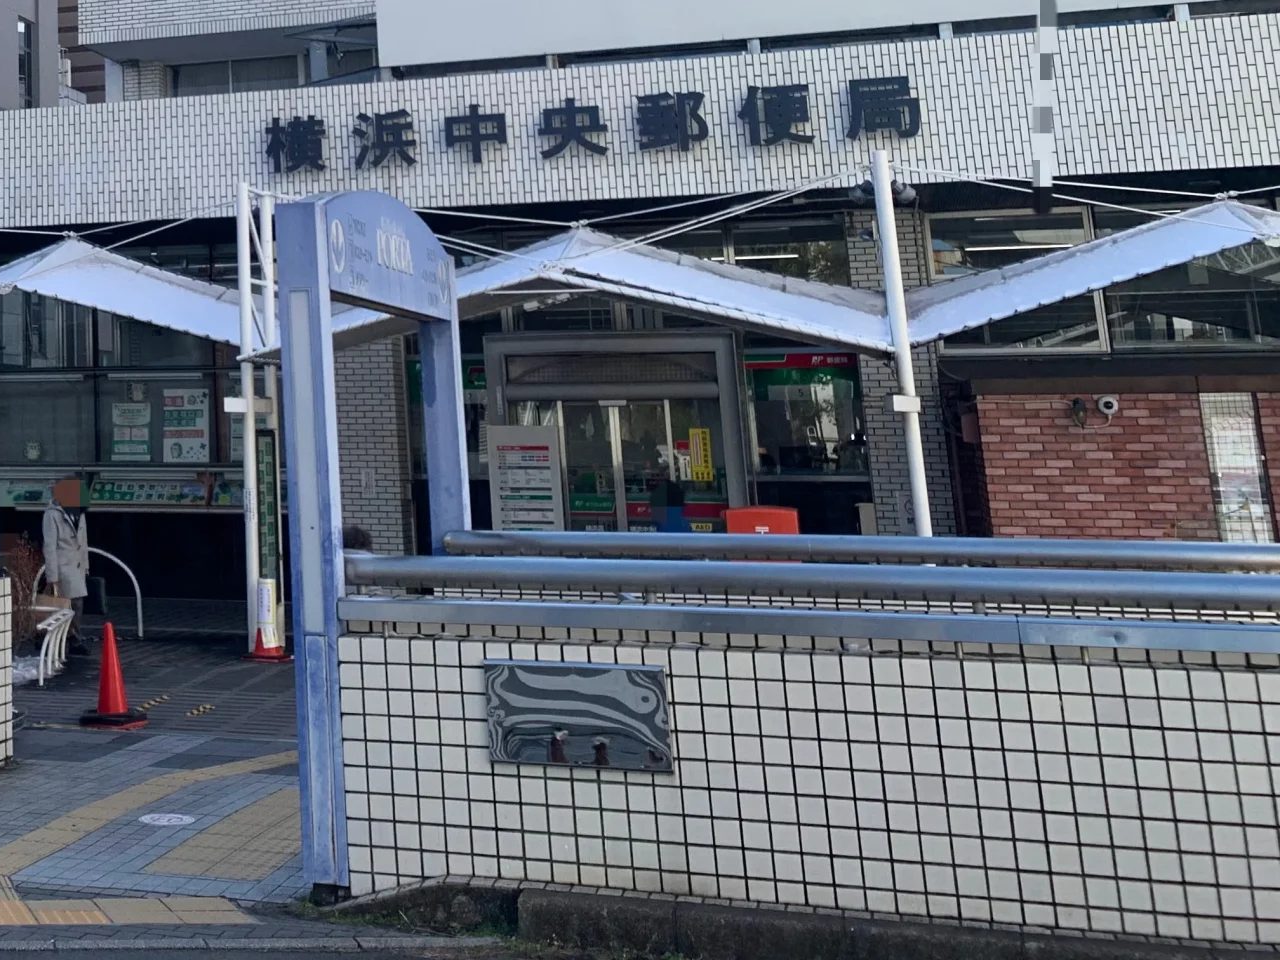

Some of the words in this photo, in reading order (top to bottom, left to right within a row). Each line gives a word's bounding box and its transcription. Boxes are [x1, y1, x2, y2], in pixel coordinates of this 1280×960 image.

[265, 75, 921, 174] 横浜中央郵便局
[376, 228, 413, 276] PORTA
